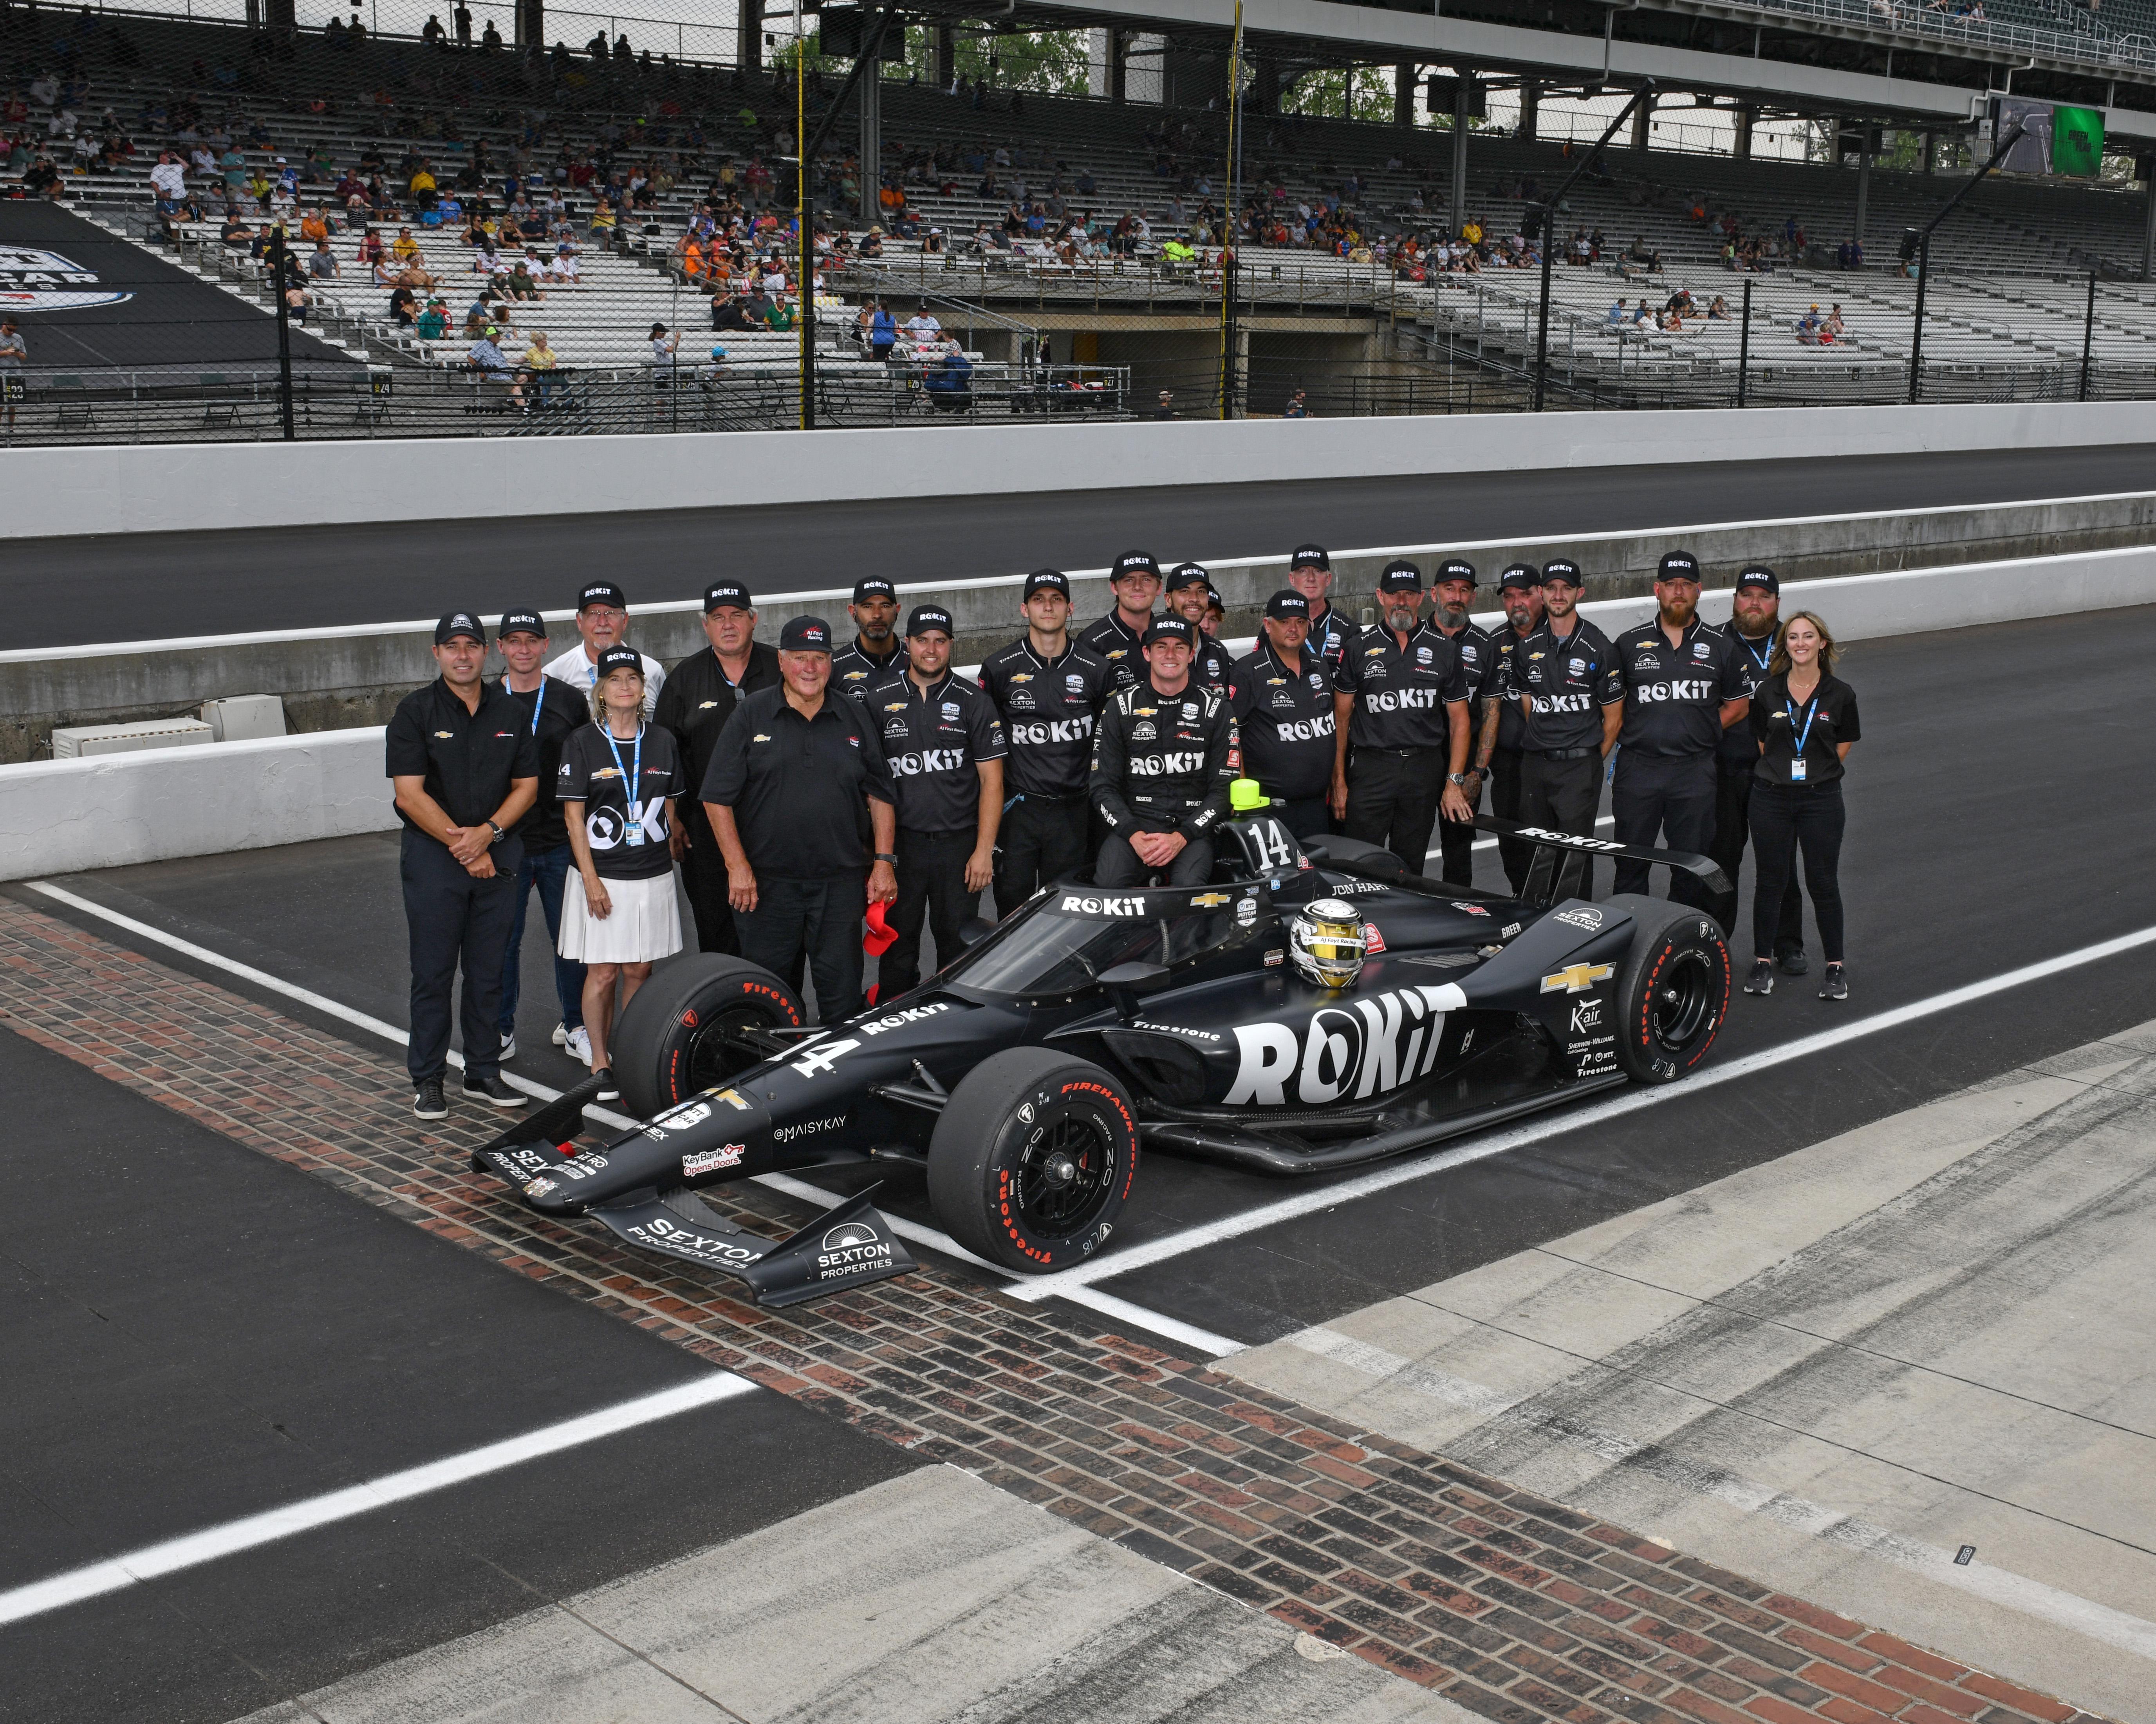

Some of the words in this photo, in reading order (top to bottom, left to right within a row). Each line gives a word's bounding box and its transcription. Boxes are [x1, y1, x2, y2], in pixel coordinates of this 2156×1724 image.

[2068, 130, 2089, 142] GREEN
[1123, 557, 1149, 566] ROKiT
[1298, 550, 1321, 559] ROKiT
[1448, 565, 1471, 575] ROKiT
[1548, 564, 1572, 573] ROKiT
[1667, 560, 1691, 569] ROKiT
[1034, 574, 1062, 584] ROKiT
[1181, 568, 1205, 578] ROKiT
[1391, 571, 1415, 579] ROKiT
[1503, 570, 1524, 579] ROKiT
[1744, 572, 1769, 581] ROKiT
[585, 587, 611, 597] ROKiT
[711, 587, 739, 598] ROKiT
[863, 581, 889, 590] ROKiT
[1281, 599, 1305, 608] ROKiT
[509, 615, 536, 625] ROKiT
[919, 612, 947, 623] ROKiT
[1156, 620, 1186, 630] ROKiT
[1702, 626, 1723, 638] Firestone
[1092, 628, 1113, 642] Firestone
[1424, 629, 1446, 640] Firestone
[1524, 633, 1544, 644] Firestone
[607, 651, 635, 662] ROKiT
[832, 651, 856, 663] Firestone
[999, 651, 1024, 664] Firestone
[1074, 653, 1096, 667] Firestone
[876, 681, 901, 692] Firestone
[952, 682, 973, 696] Firestone
[1638, 680, 1712, 704] ROKiT
[1117, 694, 1128, 716] sparco
[1365, 688, 1437, 710] ROKiT
[1207, 698, 1221, 718] sparco
[1012, 714, 1093, 745] ROKiT
[887, 748, 964, 779] ROKiT
[1130, 751, 1205, 776] ROKiT
[1248, 820, 1291, 871] 14
[1514, 827, 1627, 850] ROKiT
[1332, 884, 1355, 896] JON
[1061, 896, 1145, 916] ROKiT
[1553, 916, 1596, 931] PROPERTIES
[1558, 912, 1602, 928] SEXTON
[1501, 922, 1522, 939] GREER
[1674, 949, 1694, 962] RACING
[1717, 940, 1731, 1026] FIREHAWK
[1642, 945, 1672, 1045] Firestone
[742, 982, 800, 1026] Firesto
[859, 1003, 949, 1035] ROKiT
[1132, 1021, 1221, 1042] Firestone
[1221, 982, 1468, 1105] ROKiT
[1662, 1041, 1680, 1050] RACING
[764, 1031, 861, 1078] 14
[1577, 1064, 1617, 1077] Firestone
[1061, 1082, 1134, 1133] FIREHAWK
[773, 1115, 847, 1143] @MAISYKAY
[1092, 1113, 1112, 1142] RACING
[511, 1149, 553, 1174] SEX
[574, 1154, 605, 1168] AERO
[683, 1149, 723, 1166] KeyBank
[488, 1152, 532, 1183] PROPER
[684, 1161, 712, 1176] Opens
[713, 1156, 741, 1171] Doors.
[1122, 1172, 1133, 1200] 500
[999, 1169, 1052, 1264] Firestone
[627, 1226, 749, 1270] PROPERTIES
[818, 1243, 891, 1267] SEXTON
[821, 1258, 892, 1280] PROPERTIES
[1958, 1547, 1972, 1564] OGIO
